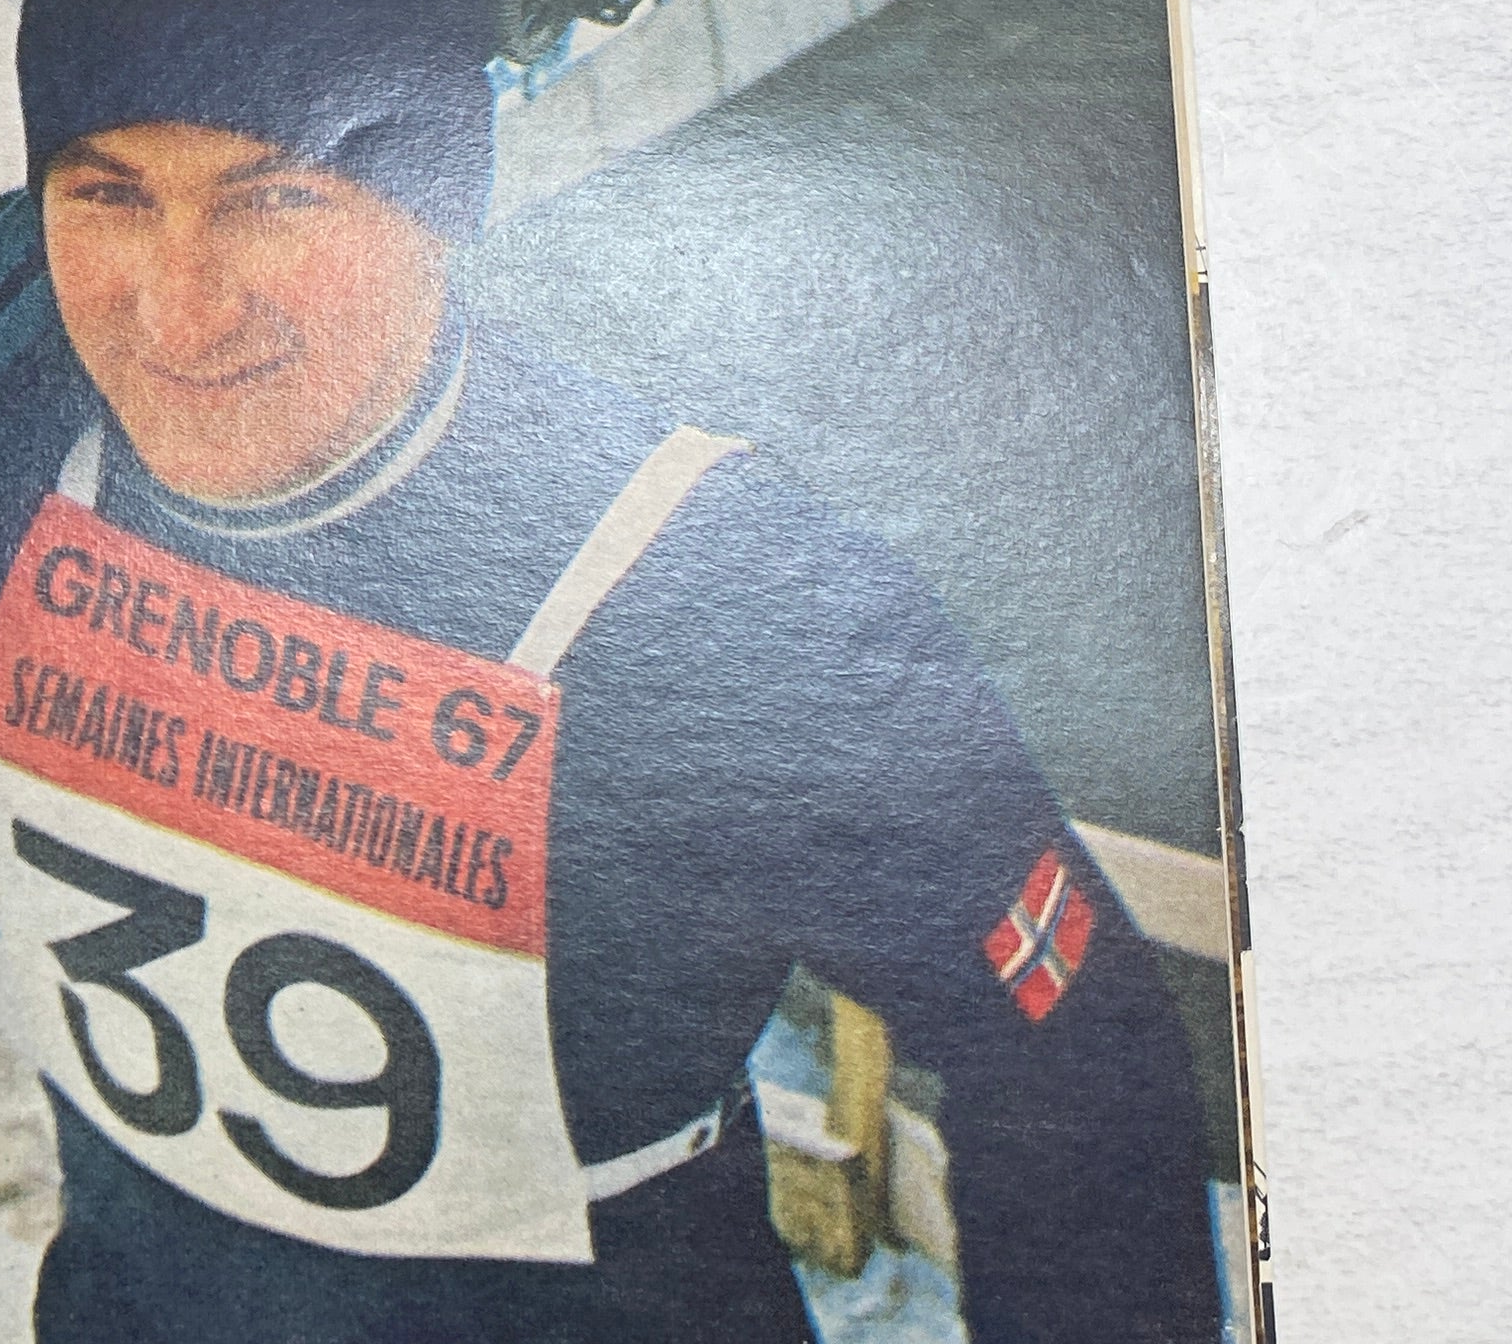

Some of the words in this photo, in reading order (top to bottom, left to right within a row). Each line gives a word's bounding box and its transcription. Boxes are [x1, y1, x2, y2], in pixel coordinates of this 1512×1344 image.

[3, 657, 181, 790] SEMAINES
[192, 728, 514, 913] INTERNATIONALES
[33, 544, 409, 742] GRENOBLE
[430, 688, 549, 783] 67
[11, 816, 444, 1211] 39
